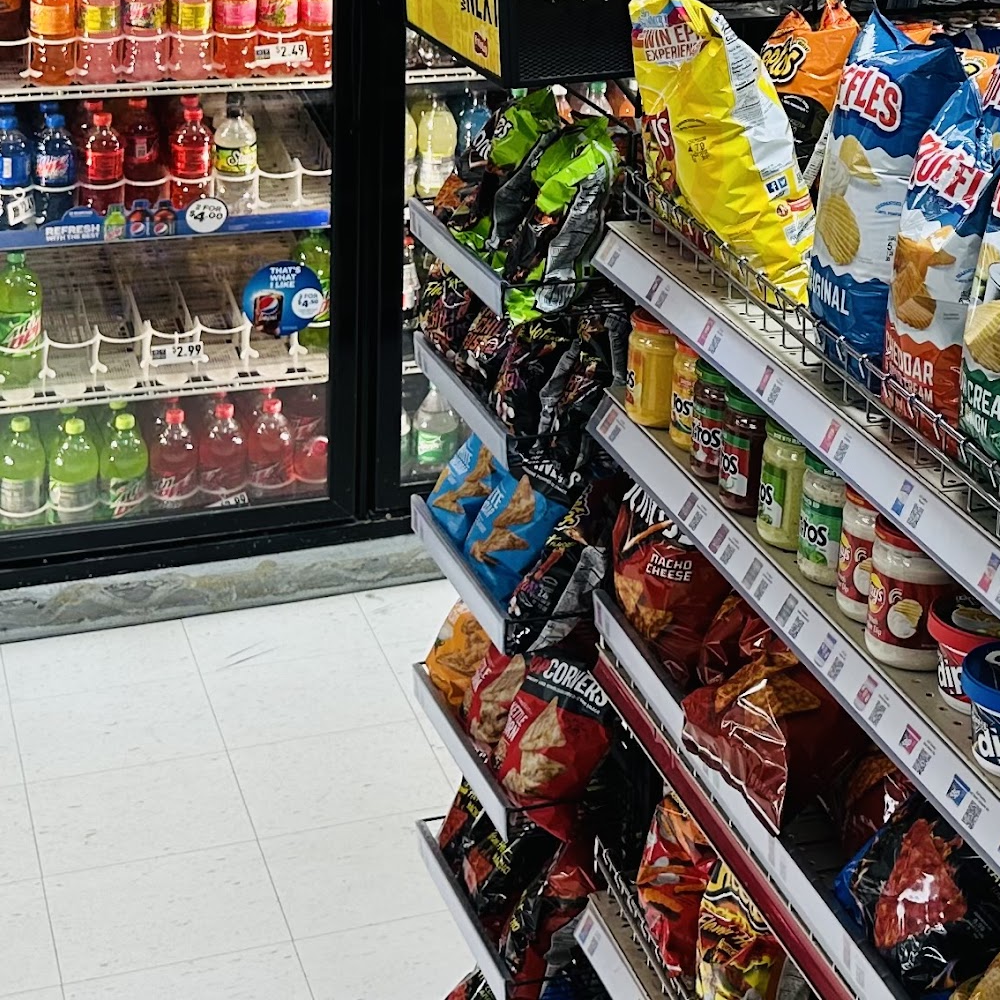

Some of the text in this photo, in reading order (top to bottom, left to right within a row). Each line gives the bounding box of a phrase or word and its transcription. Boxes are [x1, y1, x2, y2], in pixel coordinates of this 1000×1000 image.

[643, 26, 672, 49] WIN
[275, 43, 306, 59] $2.49
[202, 204, 222, 213] FOR
[45, 223, 101, 236] REFRESH
[269, 266, 302, 275] THAT'S
[269, 274, 297, 282] WHAT
[274, 281, 295, 289] LIKE
[172, 343, 202, 359] $2.99
[886, 330, 934, 387] CHEDDAR
[651, 554, 692, 570] NACHO
[645, 563, 692, 582] CHEESE
[938, 656, 963, 695] dip
